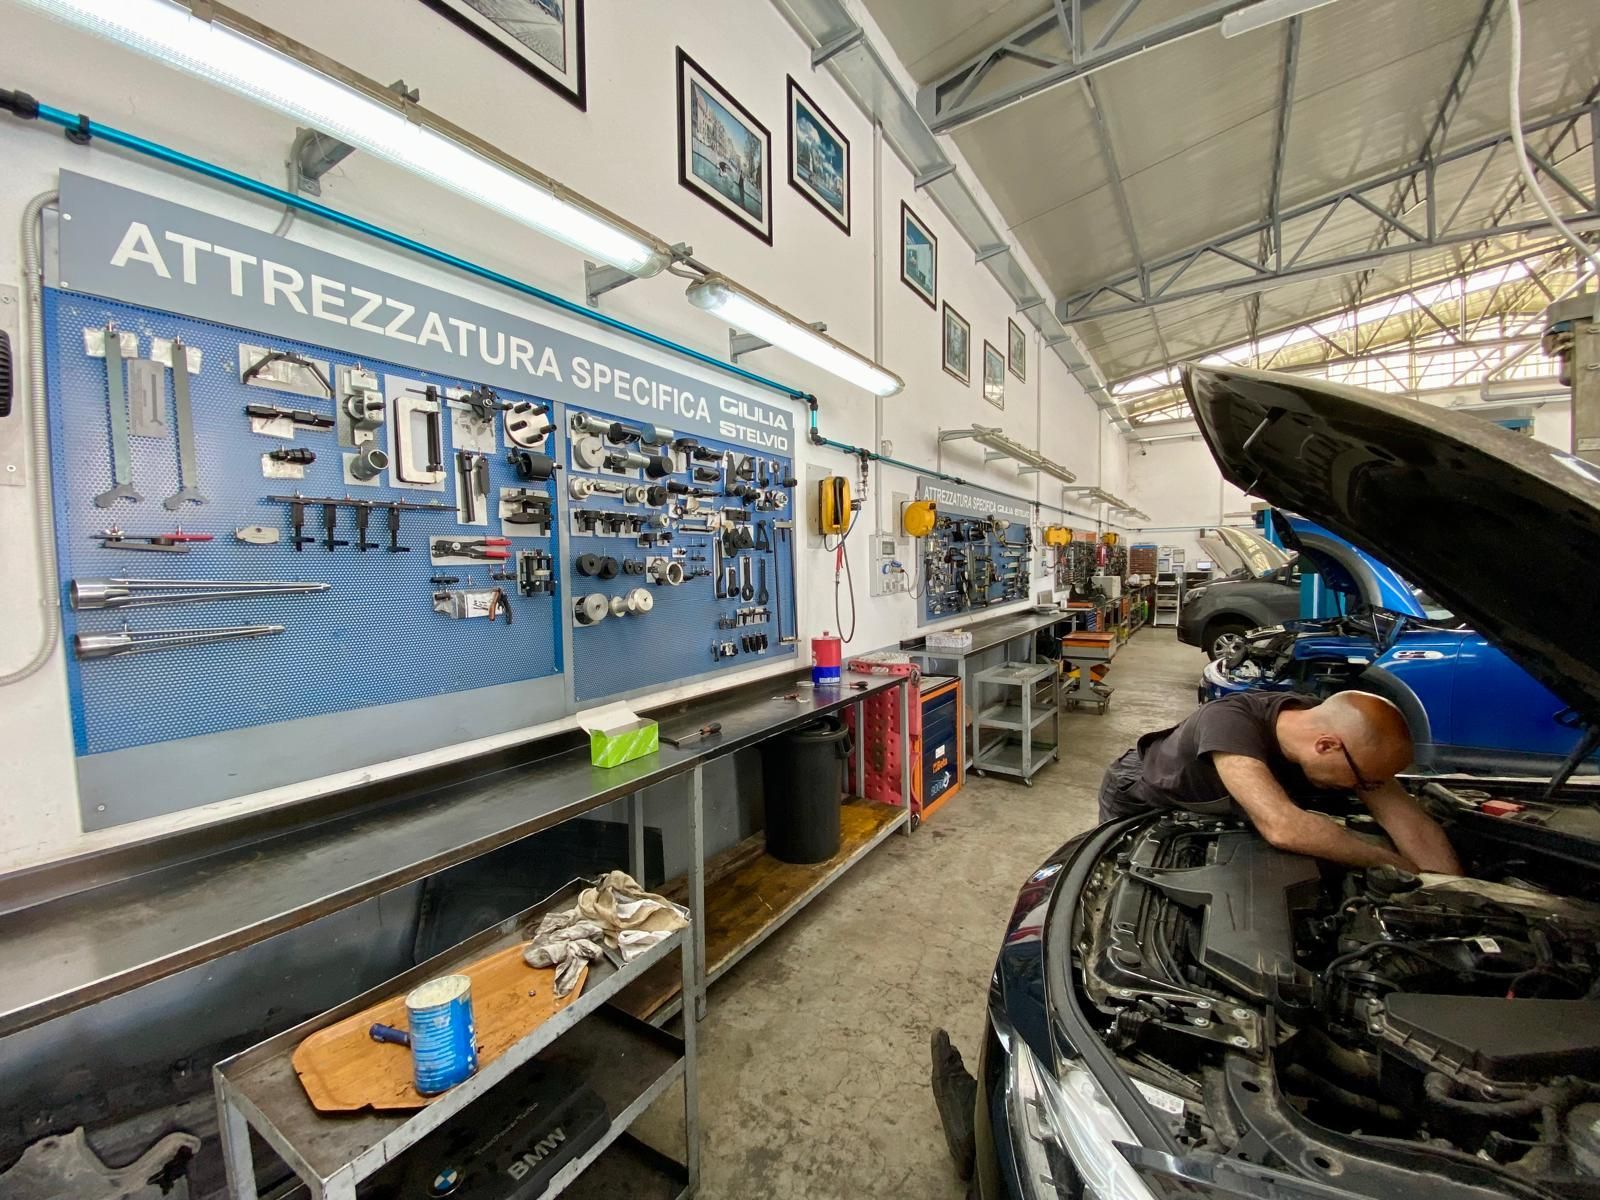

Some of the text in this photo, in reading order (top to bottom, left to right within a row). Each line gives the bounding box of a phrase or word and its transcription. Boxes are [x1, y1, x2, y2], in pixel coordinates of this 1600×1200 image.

[109, 221, 711, 423] ATTREZZATURA SPECIFICA
[720, 395, 788, 430] GIULIA
[720, 420, 787, 451] STELVIO
[924, 485, 972, 509] ATTREZZATURA
[507, 1127, 566, 1180] BMW
